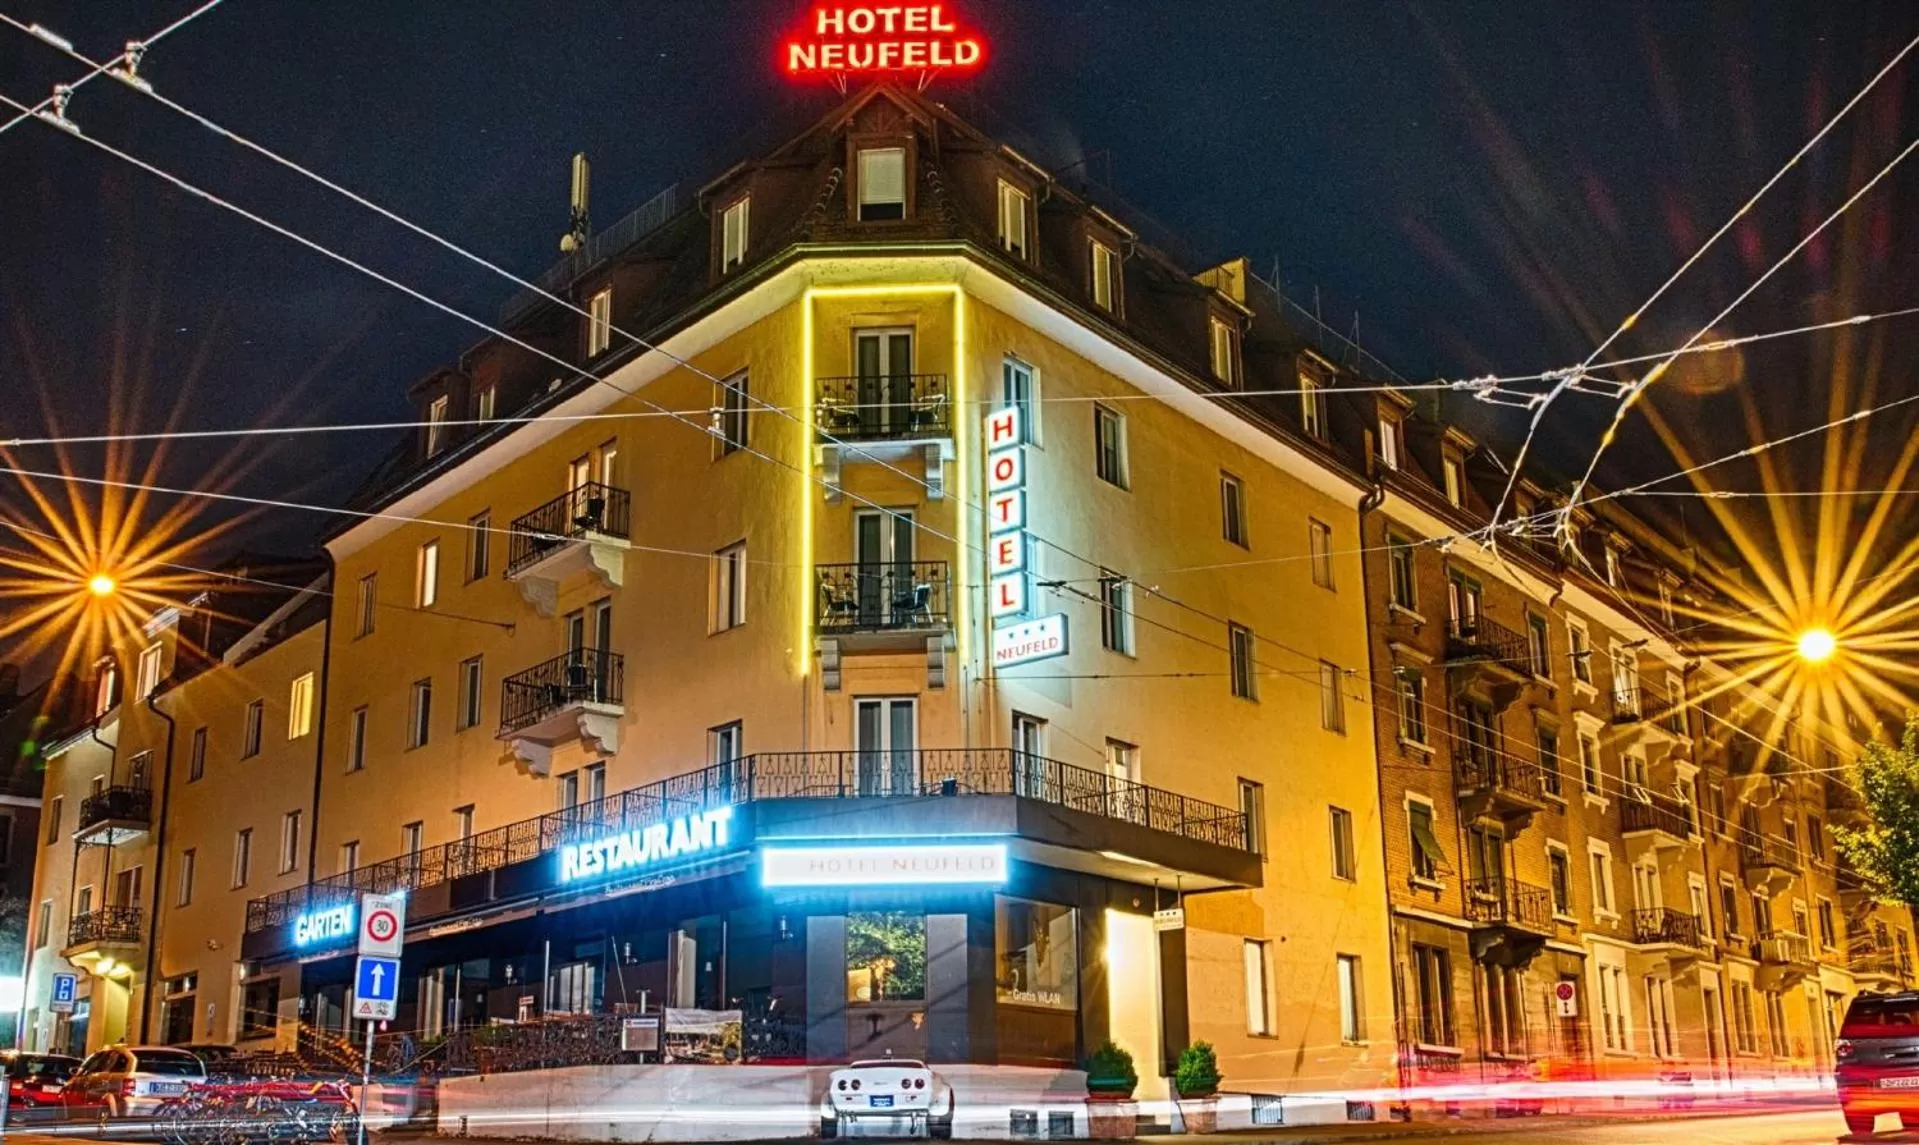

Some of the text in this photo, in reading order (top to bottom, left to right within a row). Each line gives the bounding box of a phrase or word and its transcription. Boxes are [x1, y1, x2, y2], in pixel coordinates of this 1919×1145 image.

[816, 6, 955, 35] HOTEL
[788, 40, 981, 70] NEUFELD
[993, 415, 1014, 608] HOTEL
[996, 636, 1059, 661] NEUFELD
[562, 805, 732, 883] RESTAURANT
[809, 856, 996, 874] HOTEL NEUFELD
[297, 904, 354, 947] GARTEN
[375, 919, 390, 933] 30
[61, 978, 70, 991] P
